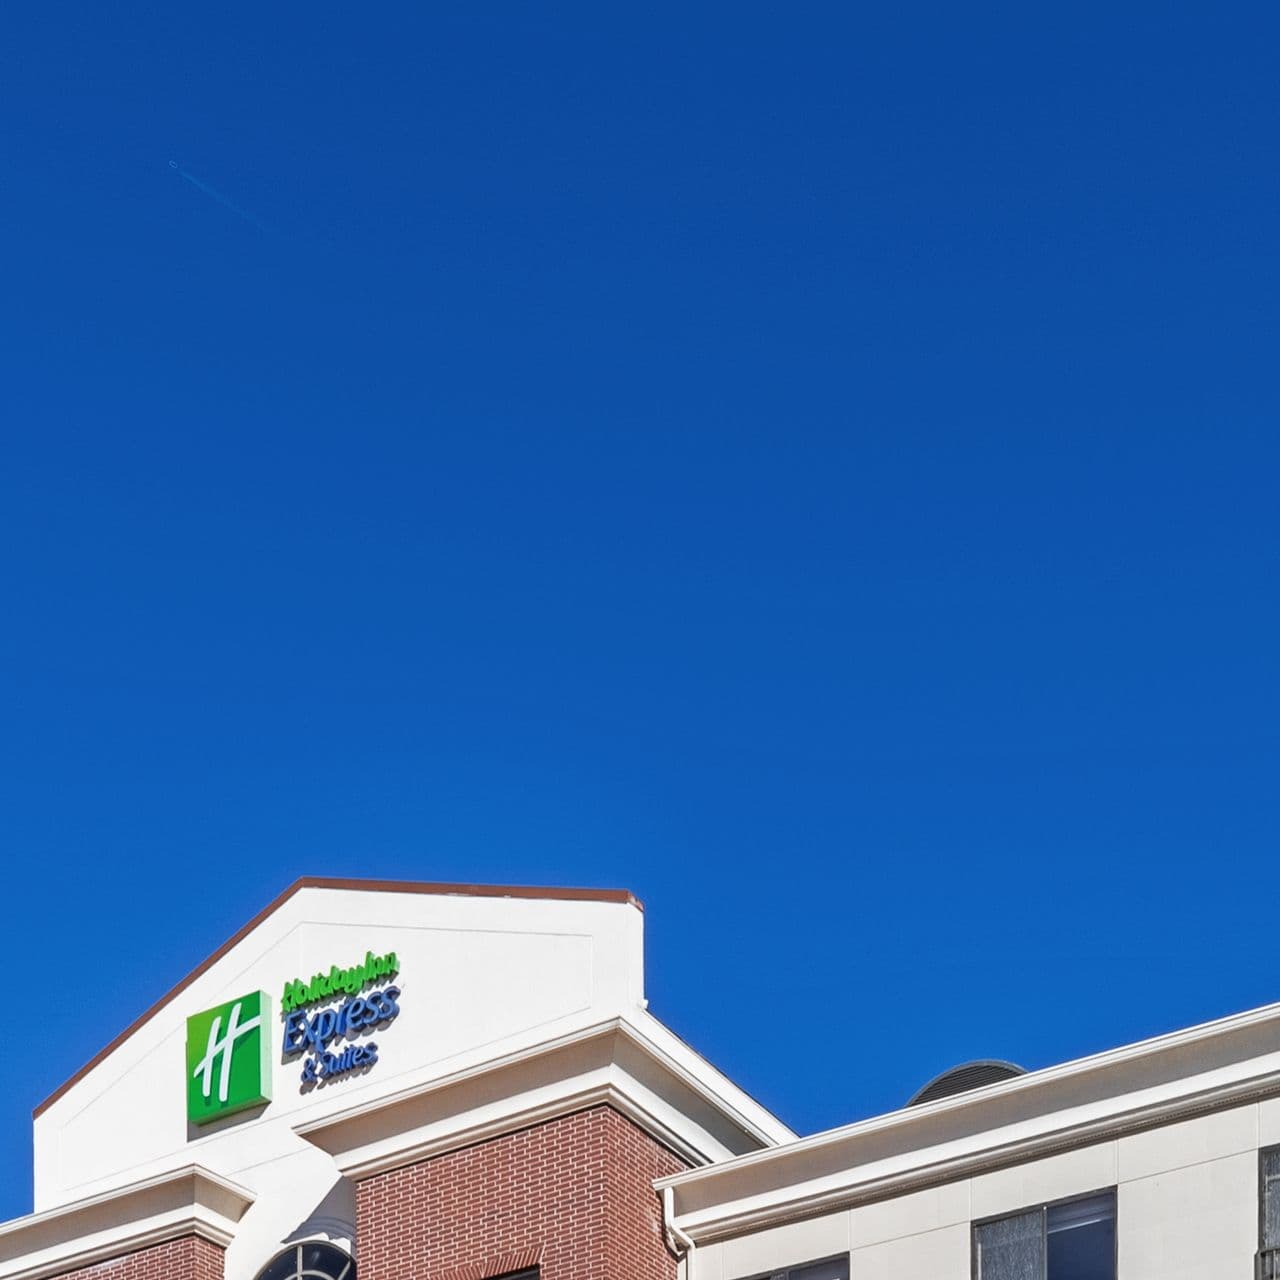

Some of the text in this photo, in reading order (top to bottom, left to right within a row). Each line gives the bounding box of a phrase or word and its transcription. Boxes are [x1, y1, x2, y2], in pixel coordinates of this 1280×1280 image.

[283, 985, 401, 1056] Express
[301, 1042, 378, 1083] & Suites
